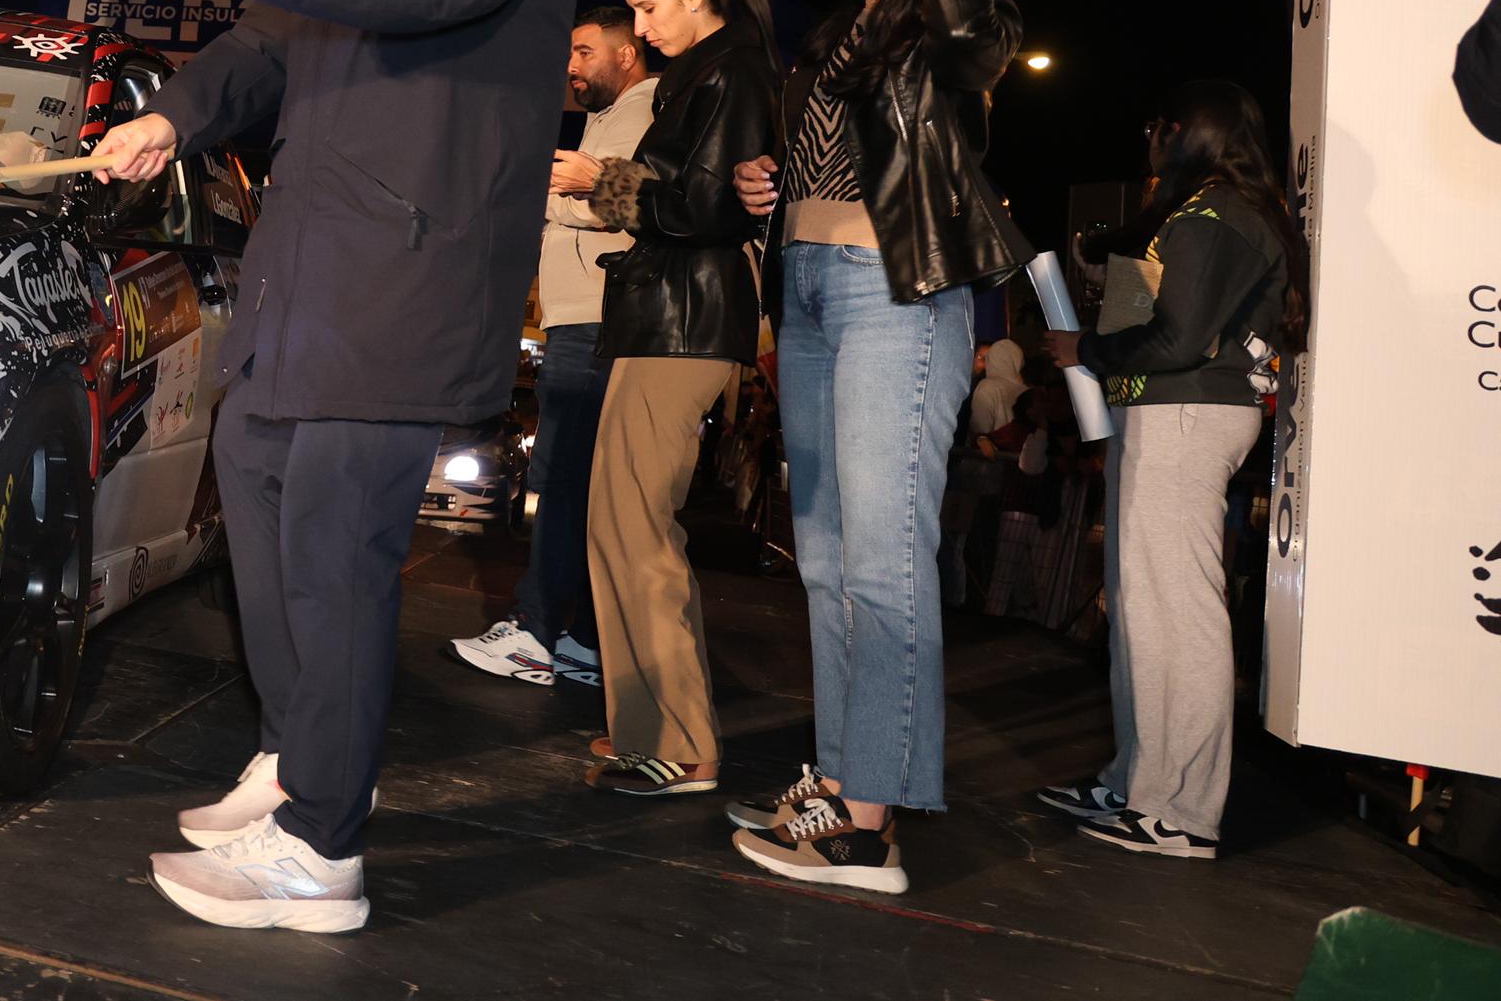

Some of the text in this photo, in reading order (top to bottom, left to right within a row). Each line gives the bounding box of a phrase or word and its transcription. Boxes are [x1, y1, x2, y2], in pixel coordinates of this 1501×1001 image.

[86, 2, 246, 23] SERVICIO INSUL
[122, 280, 146, 362] 19
